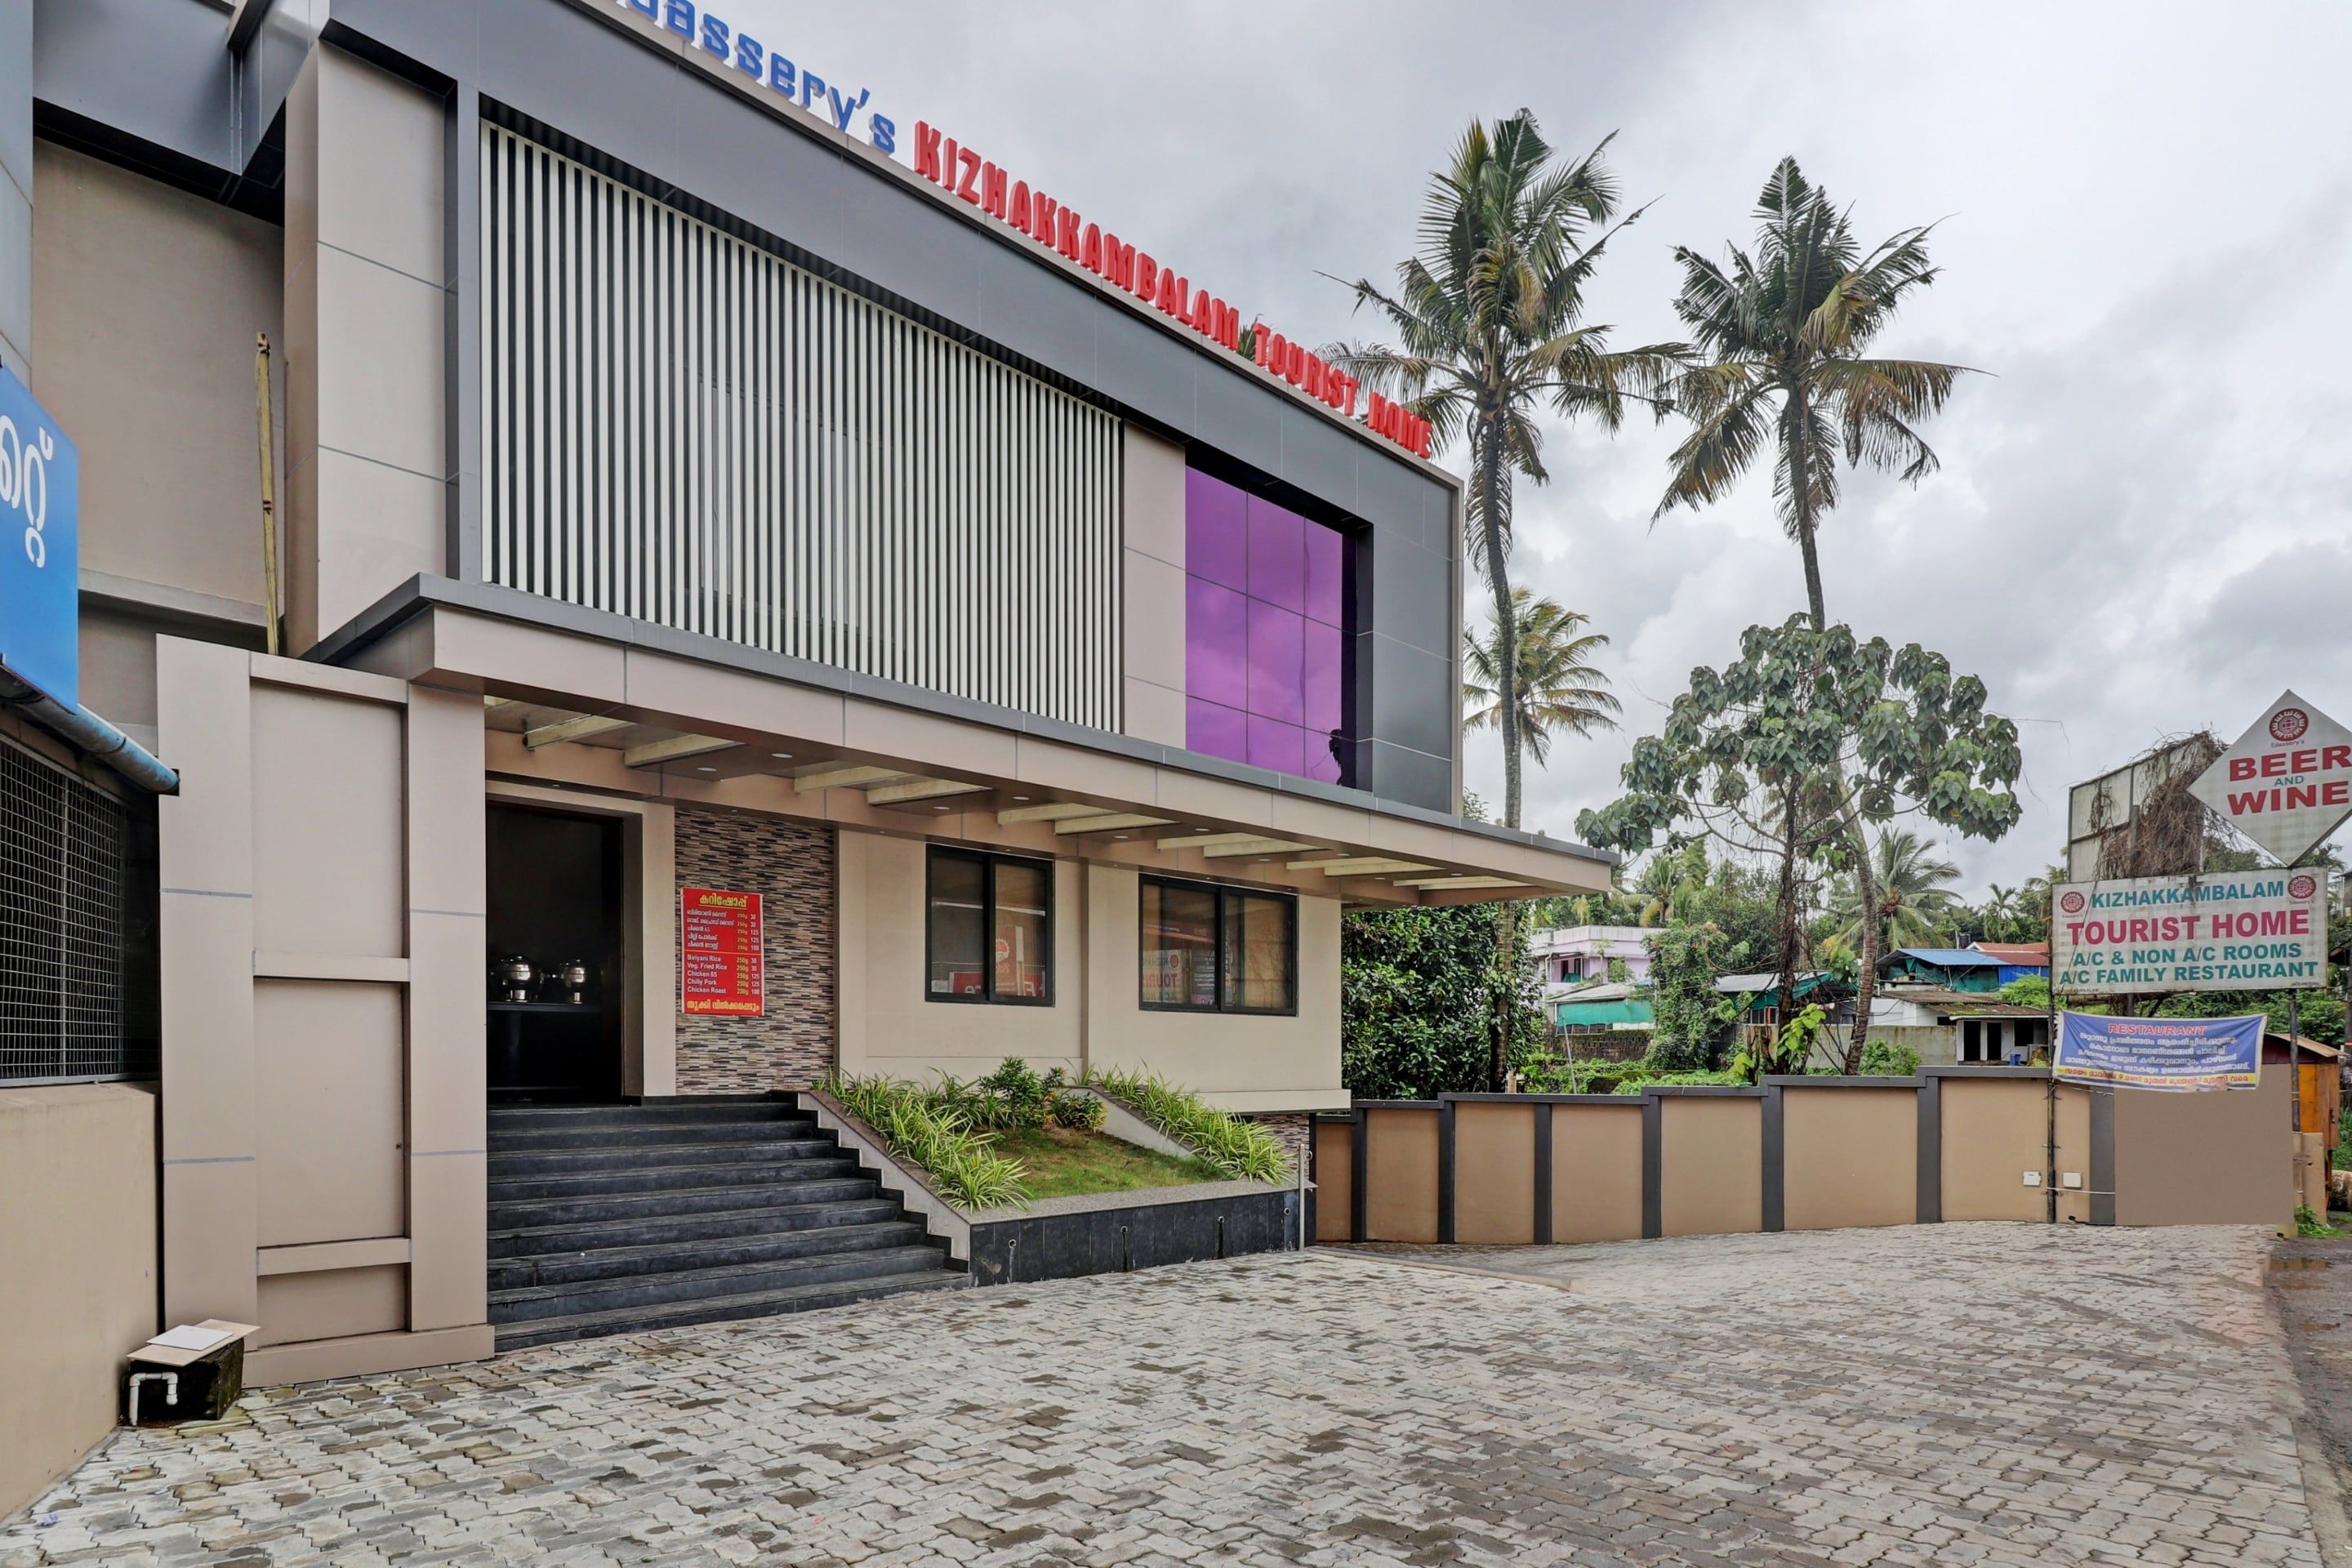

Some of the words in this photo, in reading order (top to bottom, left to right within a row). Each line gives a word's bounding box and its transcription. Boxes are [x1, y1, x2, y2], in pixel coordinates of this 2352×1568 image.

[914, 120, 1240, 351] KIZHAKKAMBALAM
[1254, 323, 1360, 416] TOURIST
[1369, 392, 1433, 459] HOME
[2230, 745, 2352, 782] BEER
[2274, 776, 2305, 786] AND
[2227, 781, 2350, 816] WINE
[2091, 880, 2284, 908] KIZHAKKAMBALAM
[2066, 915, 2201, 946] TOURIST
[2212, 909, 2310, 938] HOME
[2074, 951, 2104, 967] A/C
[2111, 951, 2125, 964] &
[2132, 949, 2176, 964] NON
[2183, 947, 2216, 962] A/C
[2224, 943, 2301, 960] ROOMS
[2060, 969, 2090, 984] A/C
[2096, 968, 2167, 983] FAMILY
[2174, 961, 2318, 980] RESTAURANT
[2109, 1023, 2207, 1036] RESTAURANT
